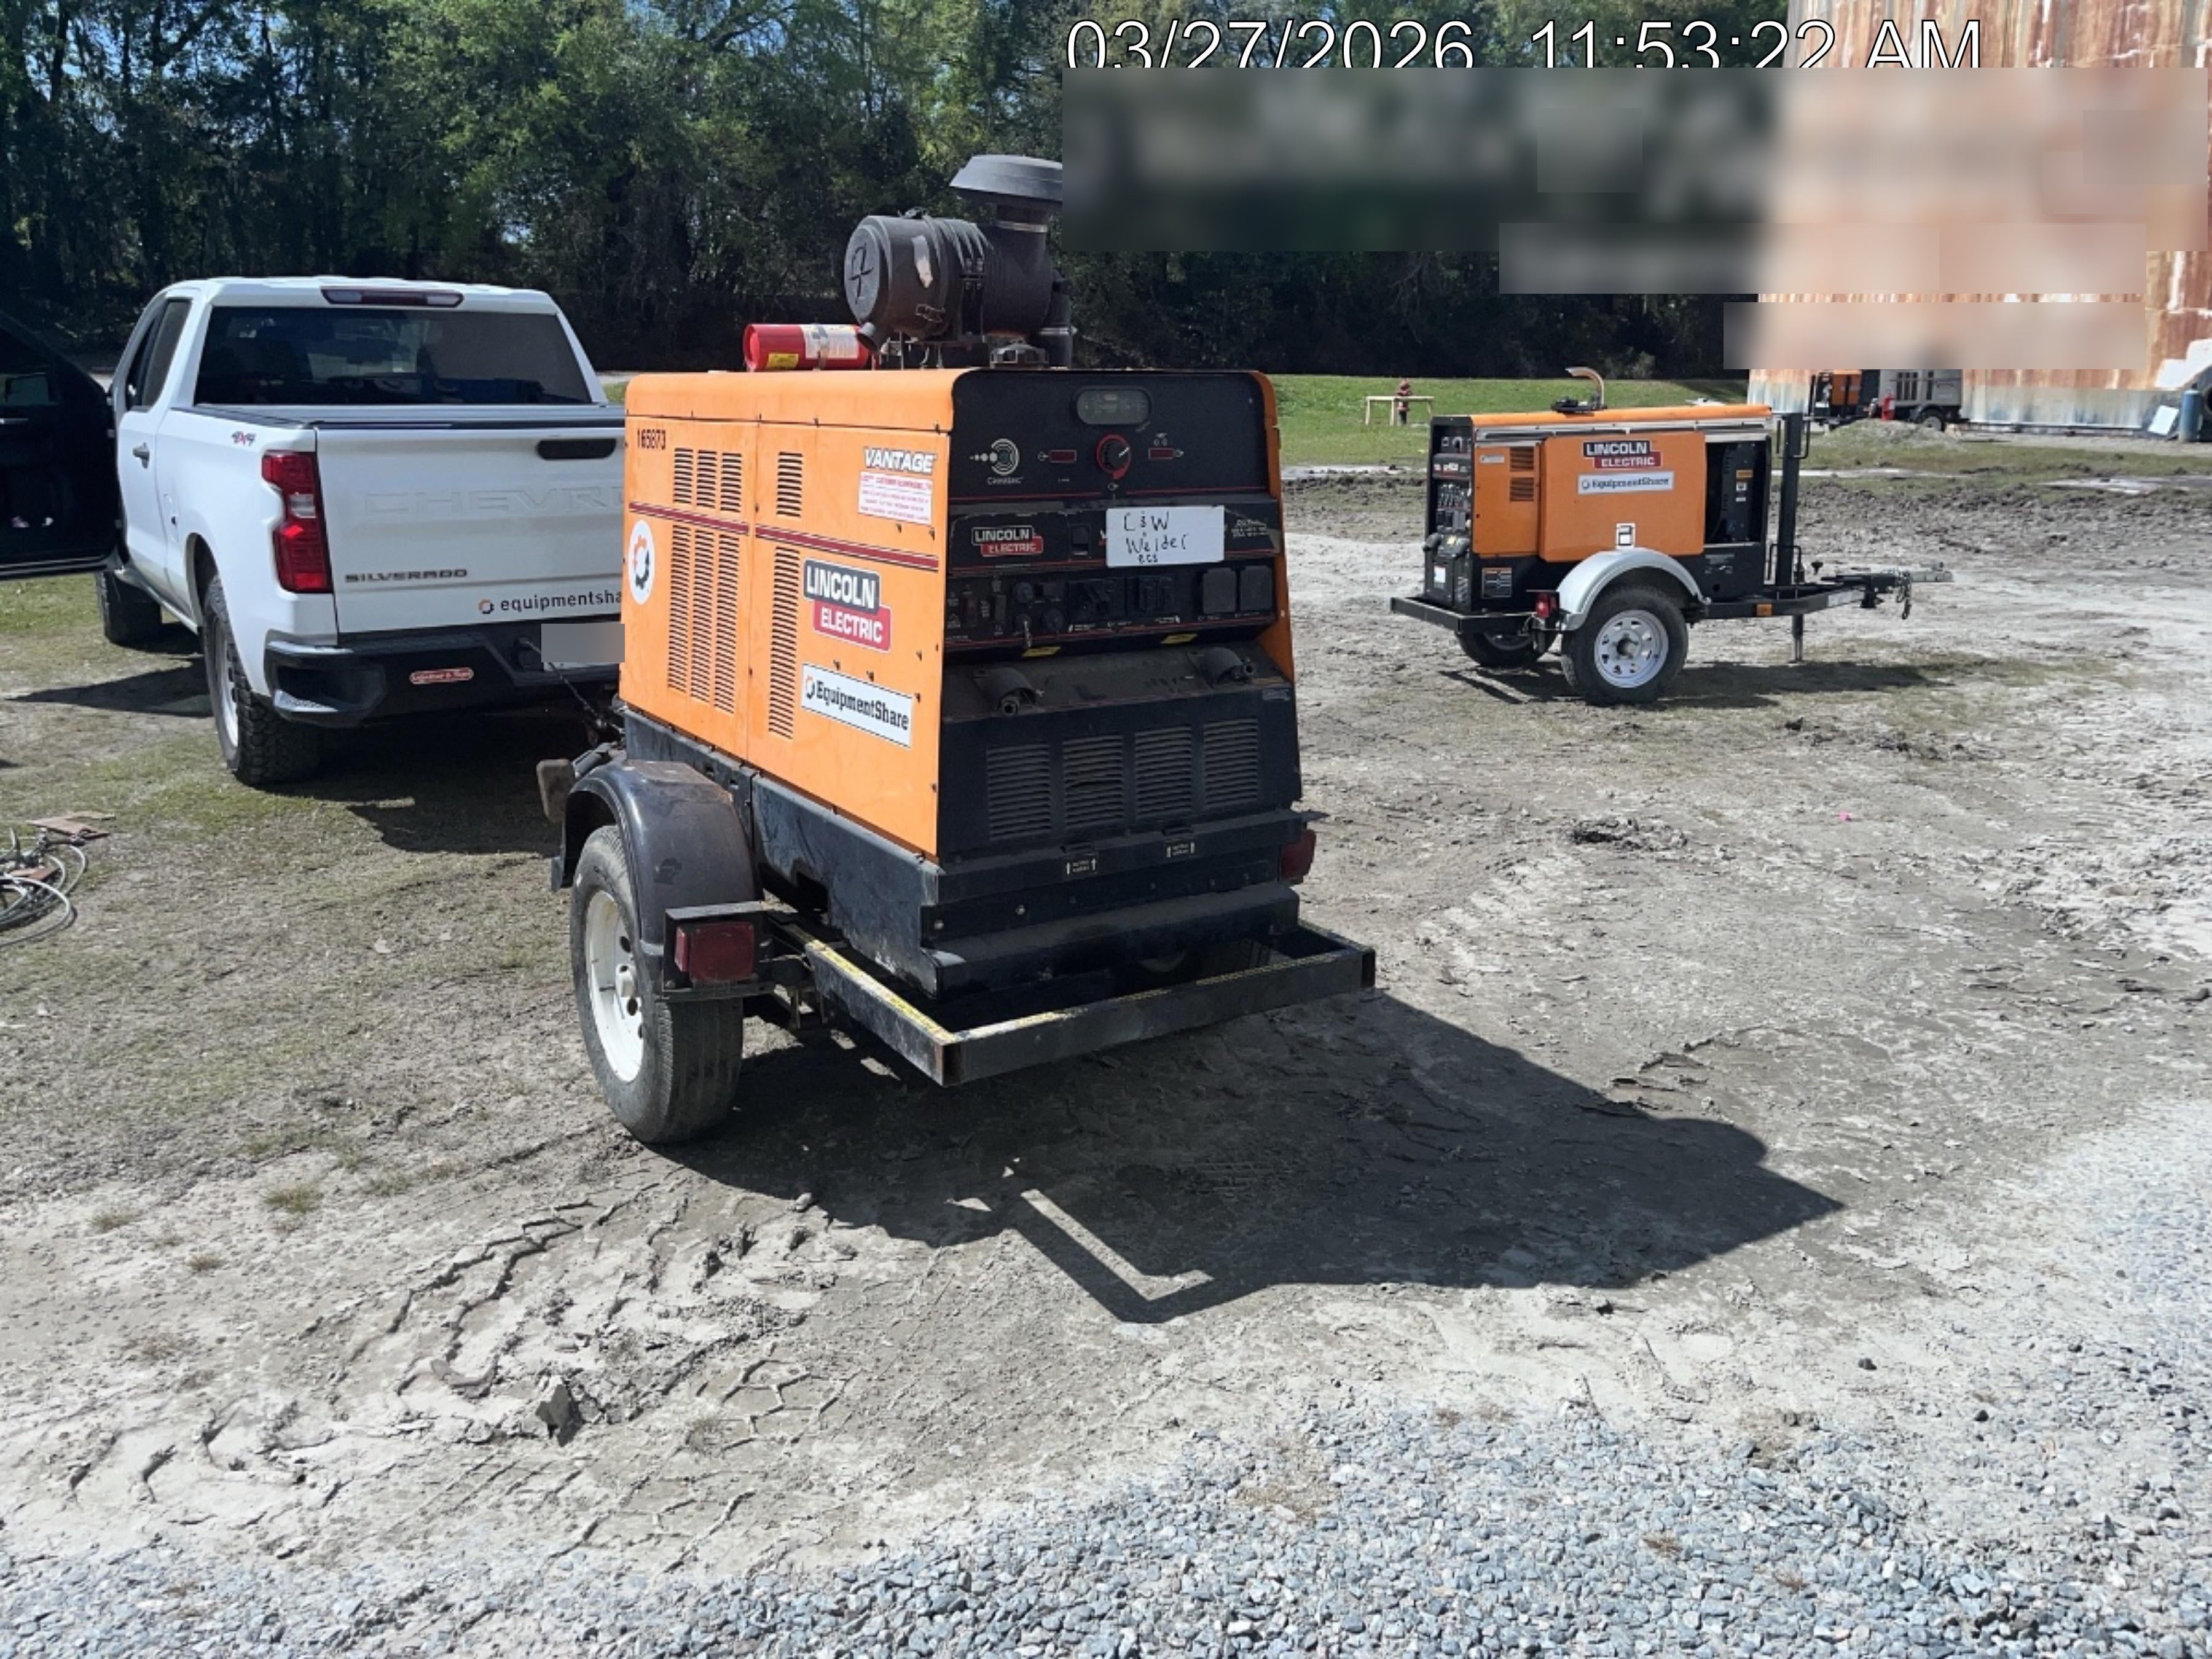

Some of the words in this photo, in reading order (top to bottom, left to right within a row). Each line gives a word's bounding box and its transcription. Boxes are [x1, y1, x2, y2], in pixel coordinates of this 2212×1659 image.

[1586, 442, 1647, 456] LINCOLN
[863, 447, 936, 475] VANTAGE
[1601, 457, 1655, 467] ELECTRIC
[974, 528, 1030, 542] LINCOLN
[988, 543, 1037, 554] ELECTRIC
[345, 568, 467, 582] SILVERADO
[806, 565, 876, 610] LINCOLN
[820, 606, 883, 644] ELECTRIC
[815, 680, 909, 730] EquipmentShare
